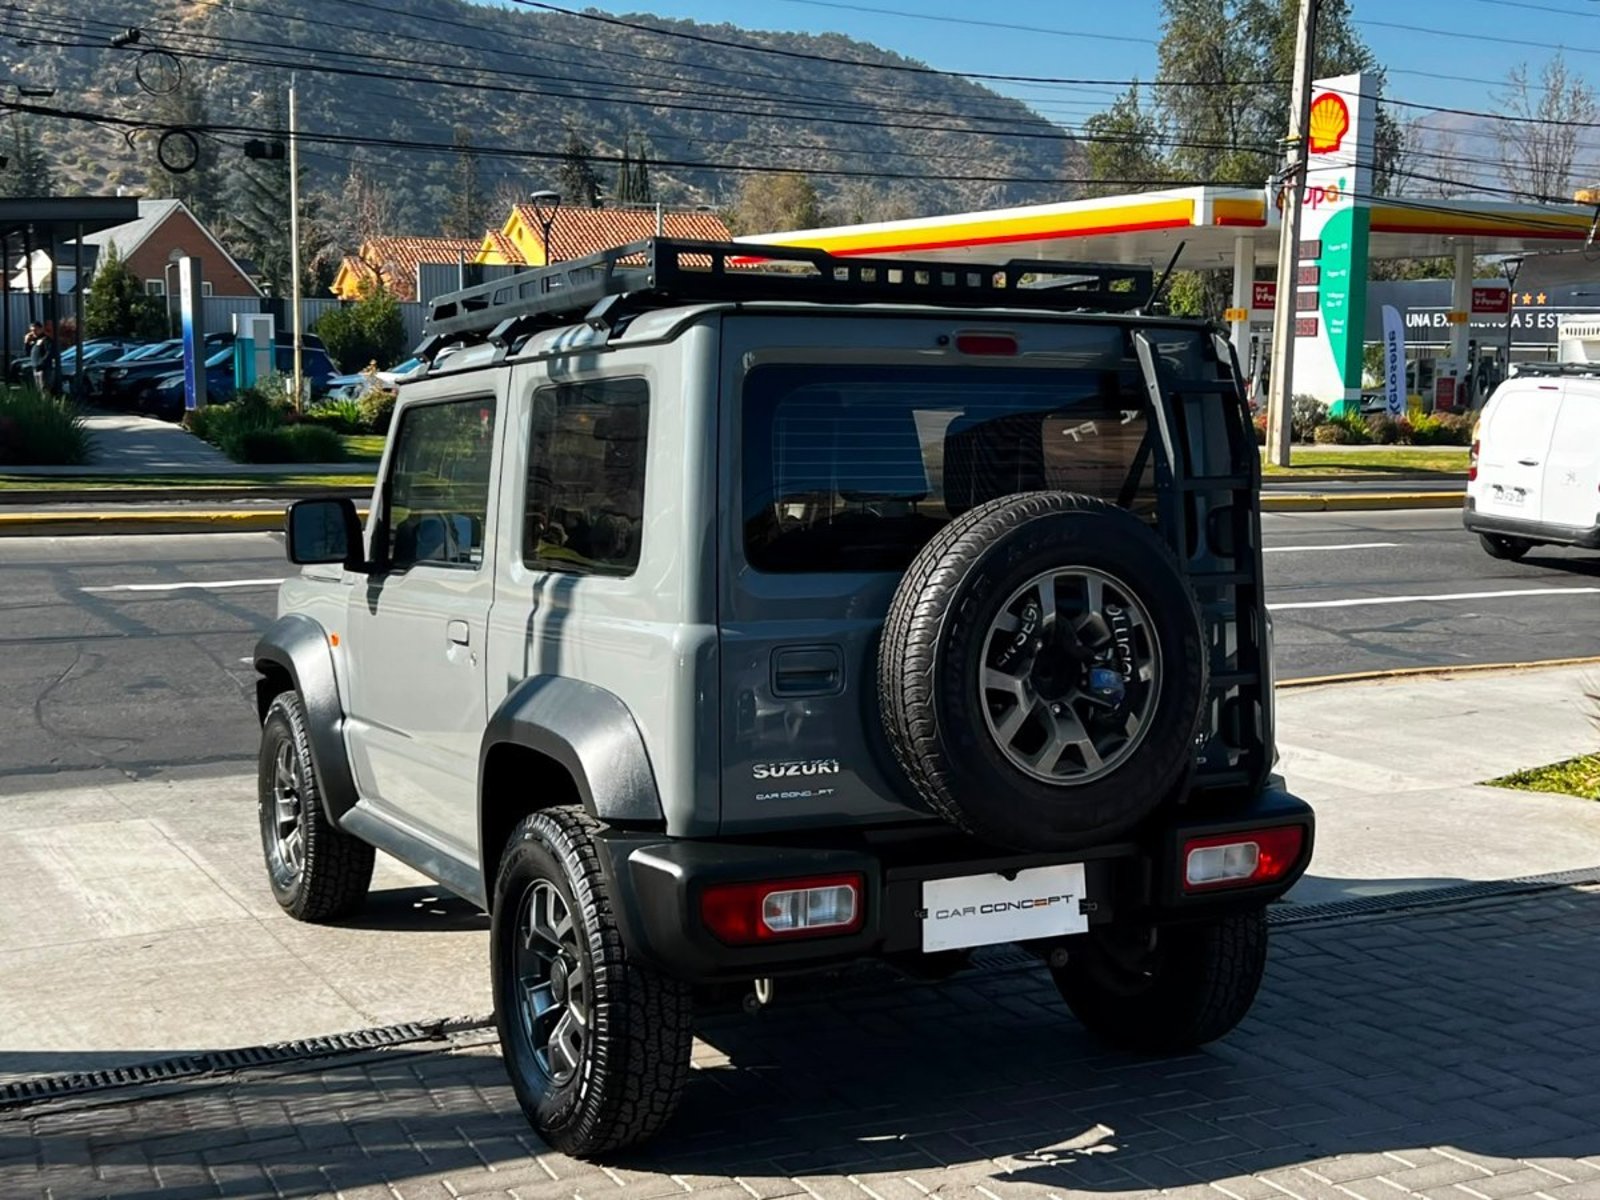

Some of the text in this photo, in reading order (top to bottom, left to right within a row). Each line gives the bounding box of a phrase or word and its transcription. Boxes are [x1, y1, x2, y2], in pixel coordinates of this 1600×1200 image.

[1406, 313, 1431, 328] UNA
[1525, 313, 1534, 328] 5
[752, 759, 839, 779] SUZUKI
[755, 793, 779, 801] CAR
[936, 894, 1074, 920] CAR CONCEPT
